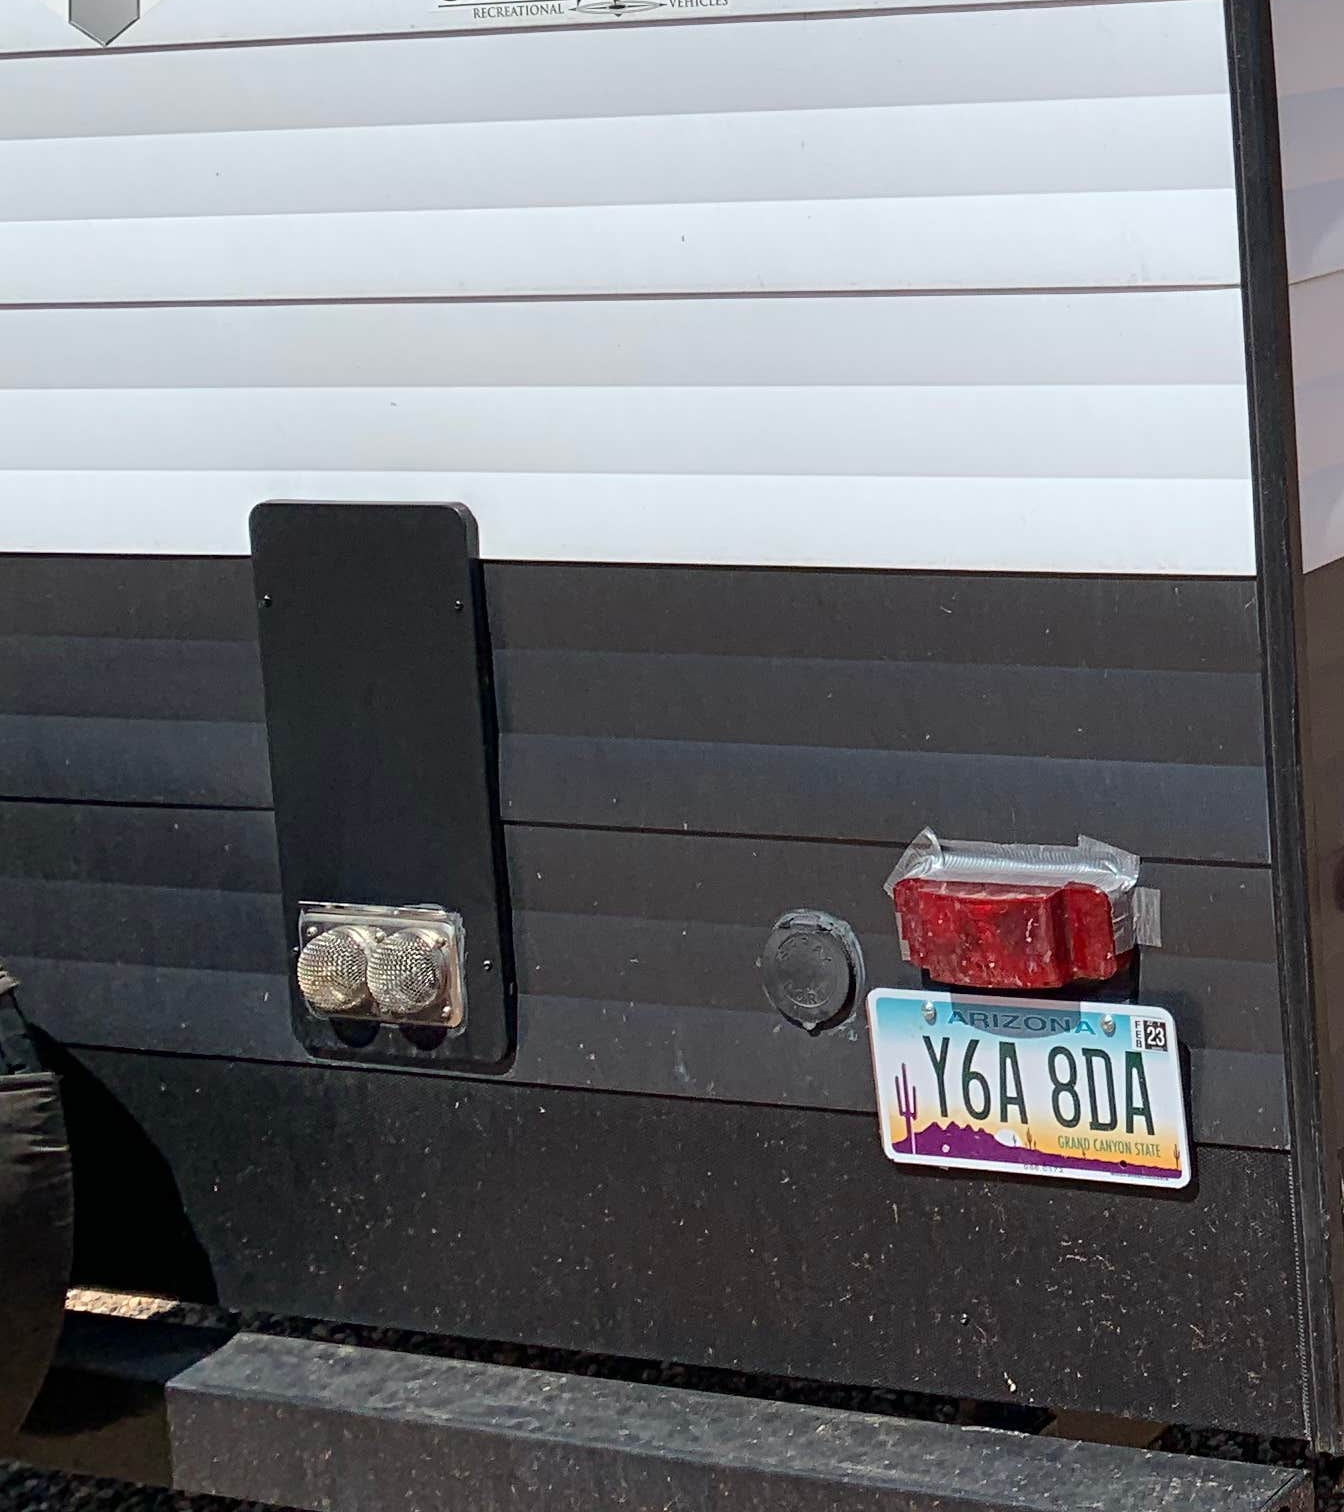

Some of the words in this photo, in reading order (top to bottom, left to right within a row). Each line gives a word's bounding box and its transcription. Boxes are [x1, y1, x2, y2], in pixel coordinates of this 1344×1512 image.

[473, 2, 565, 19] RECREATIONAL
[947, 1009, 1096, 1036] ARIZONA
[1134, 1020, 1143, 1048] FEB
[1146, 1026, 1165, 1046] 23
[922, 1035, 1028, 1125] Y6A
[1047, 1045, 1155, 1136] 8DA
[1057, 1135, 1091, 1150] GRAND
[1093, 1138, 1132, 1155] CANYON
[1135, 1142, 1161, 1158] STATE
